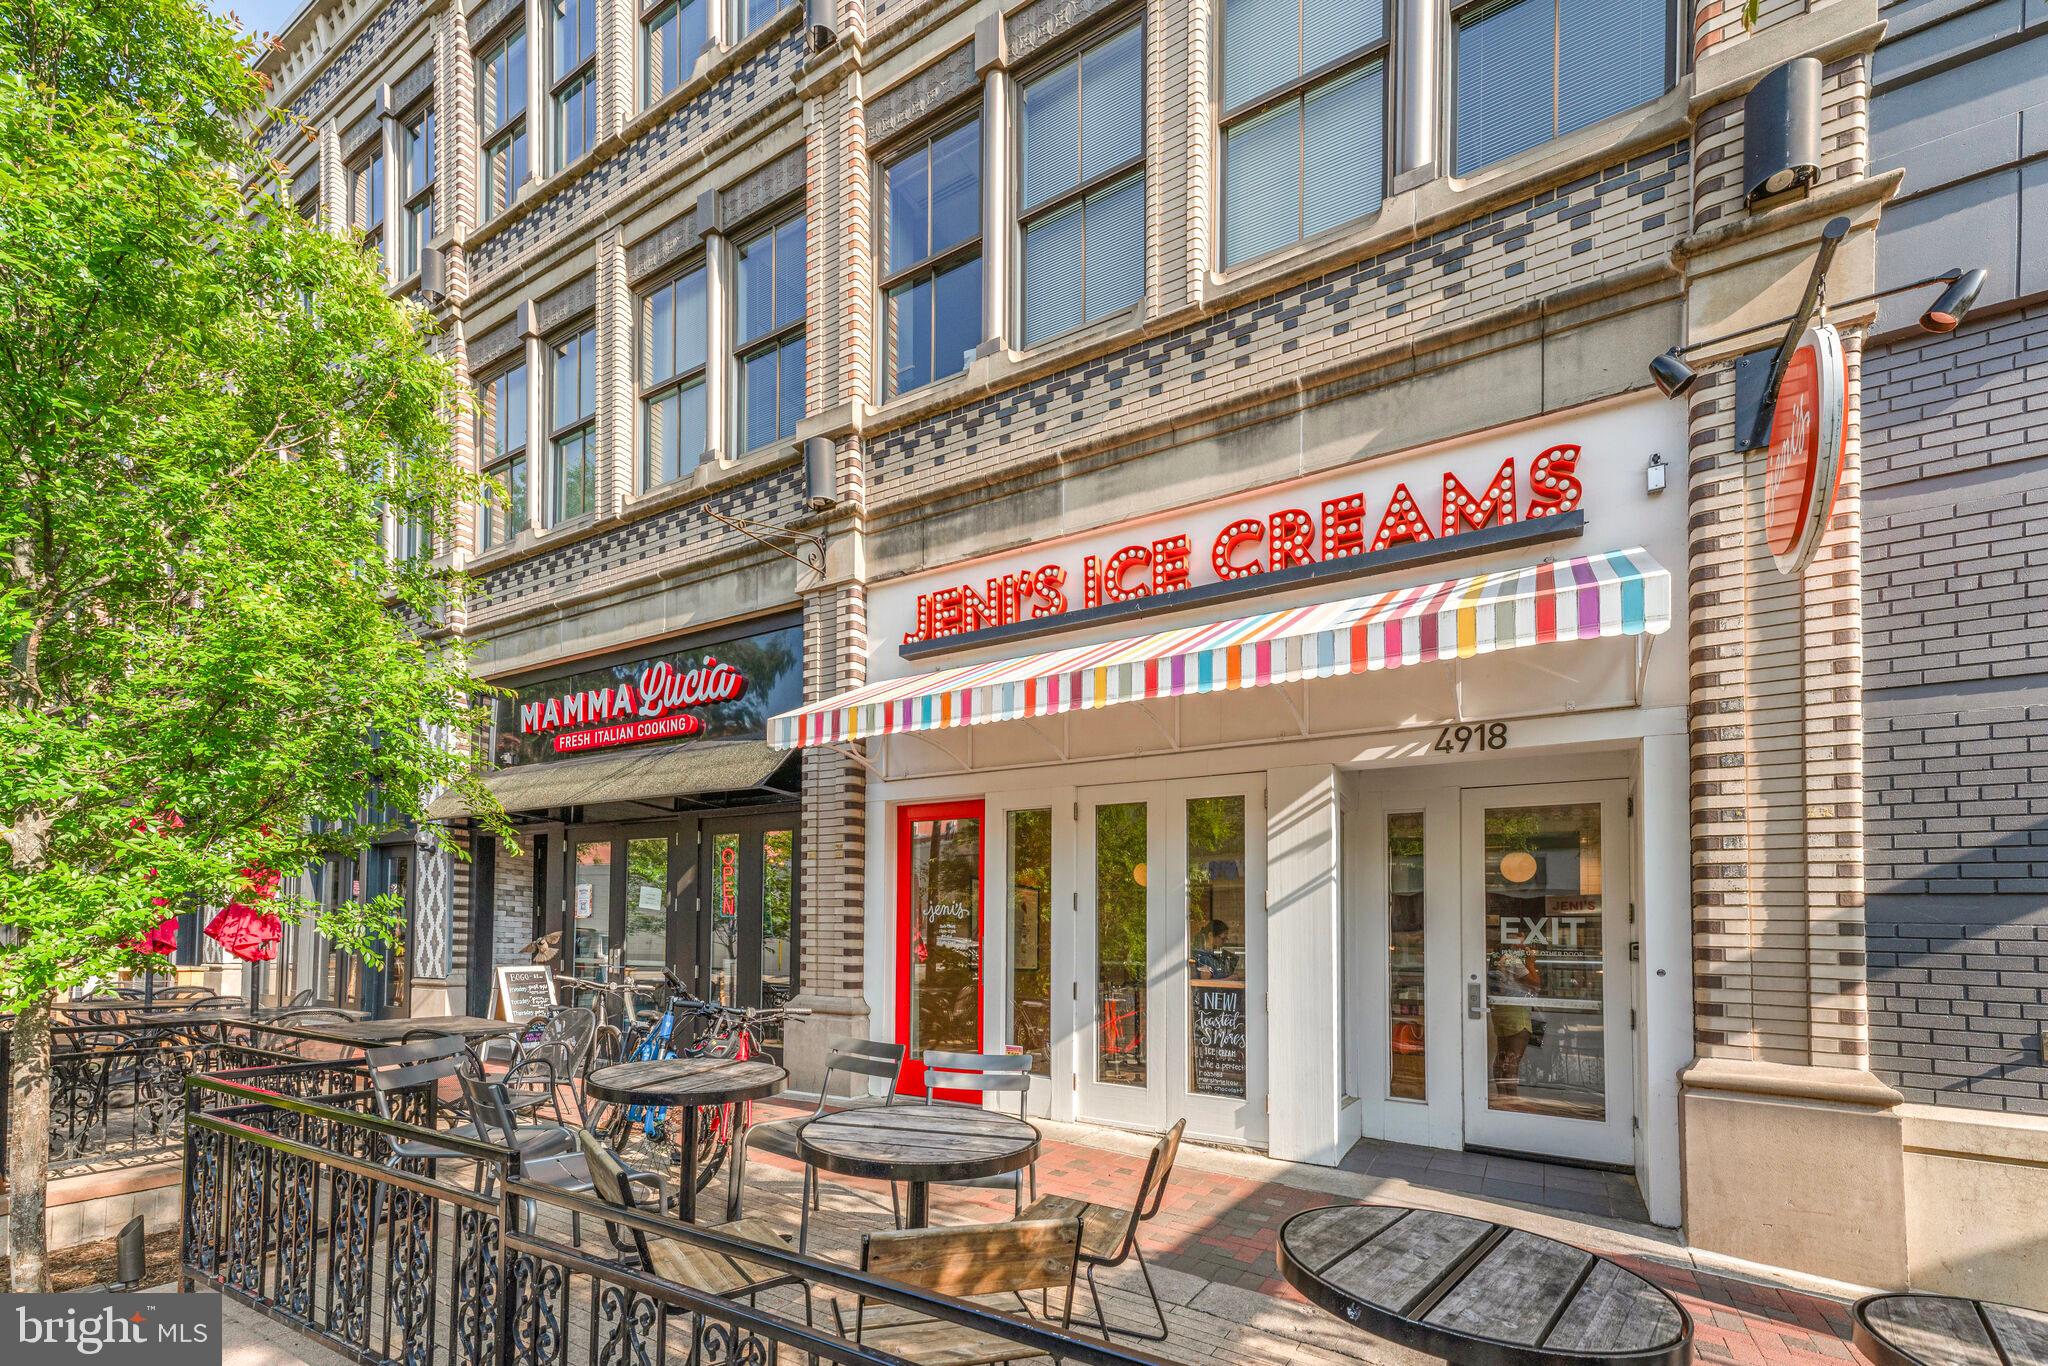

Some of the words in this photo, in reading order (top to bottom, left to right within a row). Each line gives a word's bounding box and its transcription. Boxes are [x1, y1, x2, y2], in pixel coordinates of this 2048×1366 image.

[903, 564, 1068, 645] JENI'S
[1083, 533, 1192, 609] ICE
[1211, 443, 1583, 582] CREAMS
[520, 683, 638, 734] MAMMA
[638, 655, 741, 718] Lucia
[559, 733, 591, 749] FRESH
[594, 726, 634, 743] ITALIAN
[637, 717, 687, 736] COOKING
[1434, 722, 1508, 754] 4918
[721, 847, 736, 916] OPEN
[923, 900, 970, 923] jeni's
[1552, 900, 1596, 911] JENI'S
[1500, 916, 1586, 948] EXIT
[1204, 992, 1237, 1012] NEW!
[1195, 1009, 1244, 1030] Toasted
[1198, 1058, 1214, 1069] Like
[1215, 1061, 1220, 1069] a
[1221, 1062, 1246, 1072] perfect
[1204, 1046, 1216, 1056] ICE
[1218, 1049, 1237, 1058] CREAM
